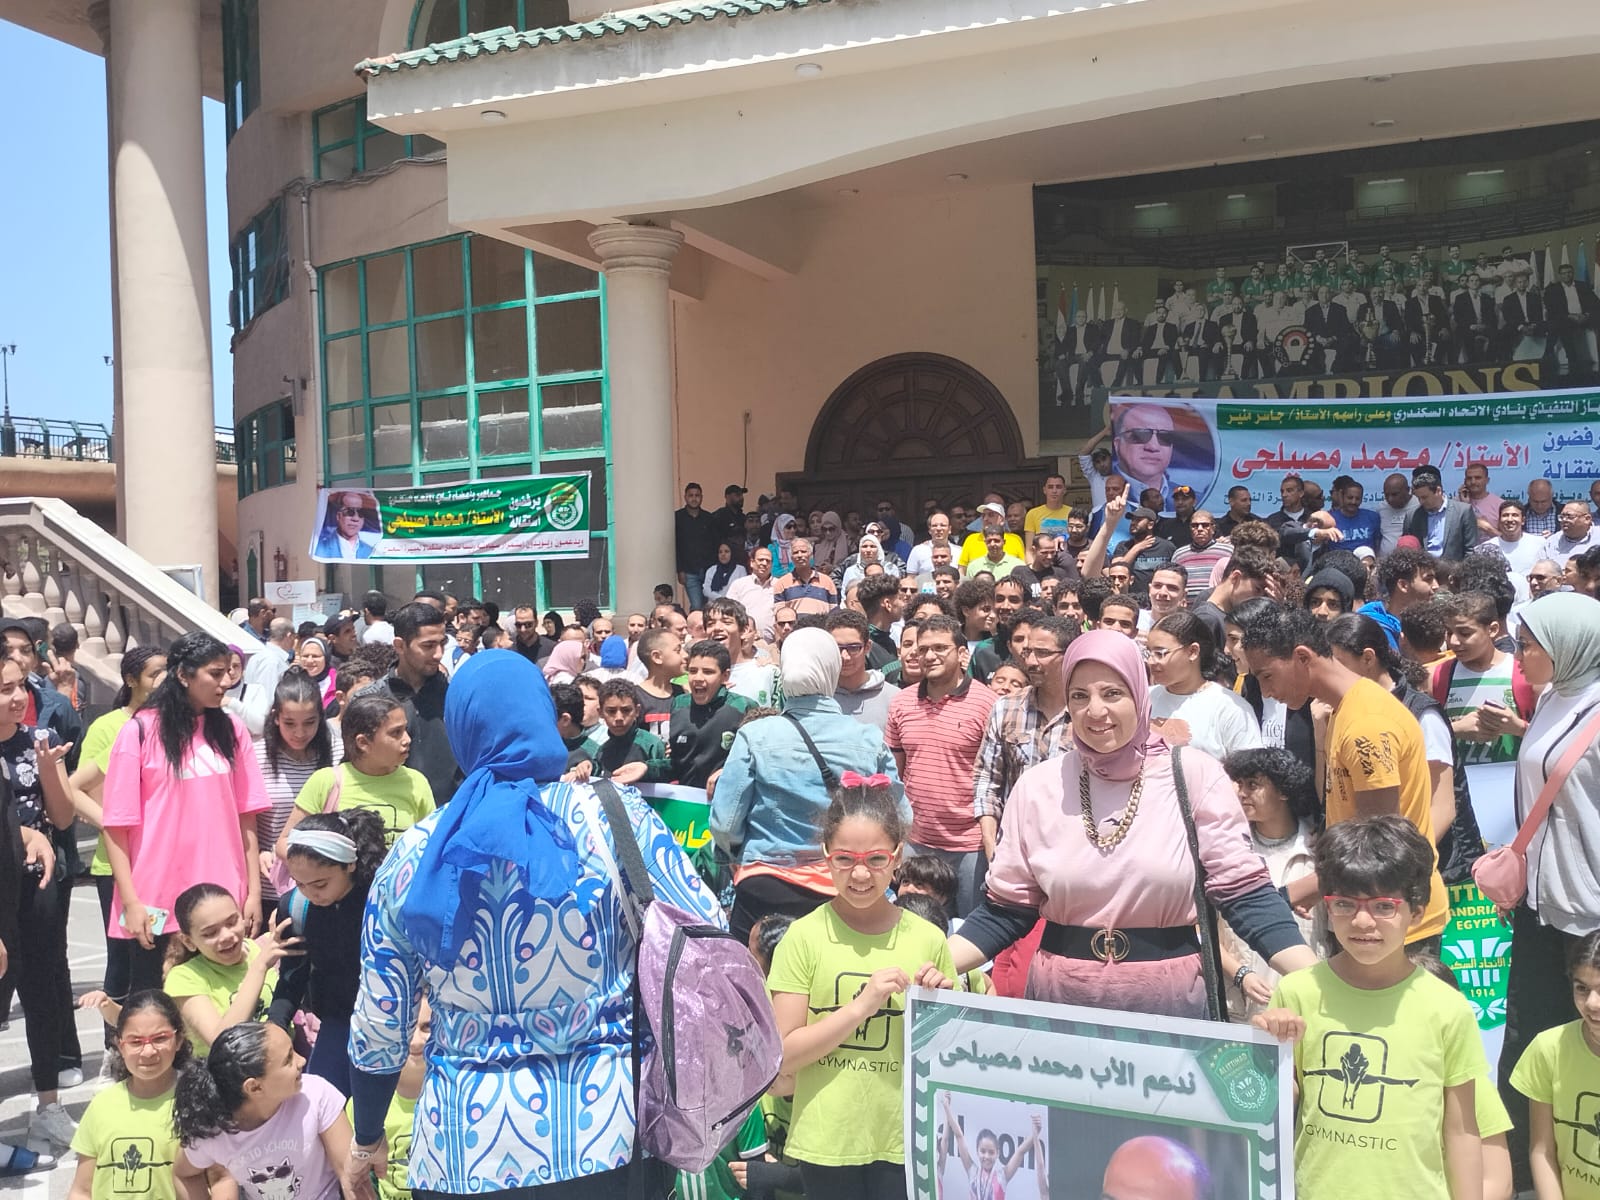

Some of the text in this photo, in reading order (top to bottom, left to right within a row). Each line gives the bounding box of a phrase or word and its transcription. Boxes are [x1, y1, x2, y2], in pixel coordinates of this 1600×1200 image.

[1448, 404, 1490, 417] الاتحاد
[1492, 405, 1527, 421] بنادي
[1529, 399, 1578, 420] التنفيذي
[1542, 426, 1600, 452] رفضون
[1351, 441, 1430, 471] محمد
[1342, 527, 1370, 541] LAY
[1449, 904, 1498, 918] ANDRIA
[1456, 918, 1498, 931] EGYPT
[1470, 988, 1496, 998] 1914
[818, 1055, 899, 1073] GYMNASTIC
[1028, 1053, 1083, 1079] محمد
[1091, 1060, 1135, 1089] الأب
[1143, 1070, 1197, 1098] ندعم
[1304, 1123, 1398, 1151] GYMNASTIC
